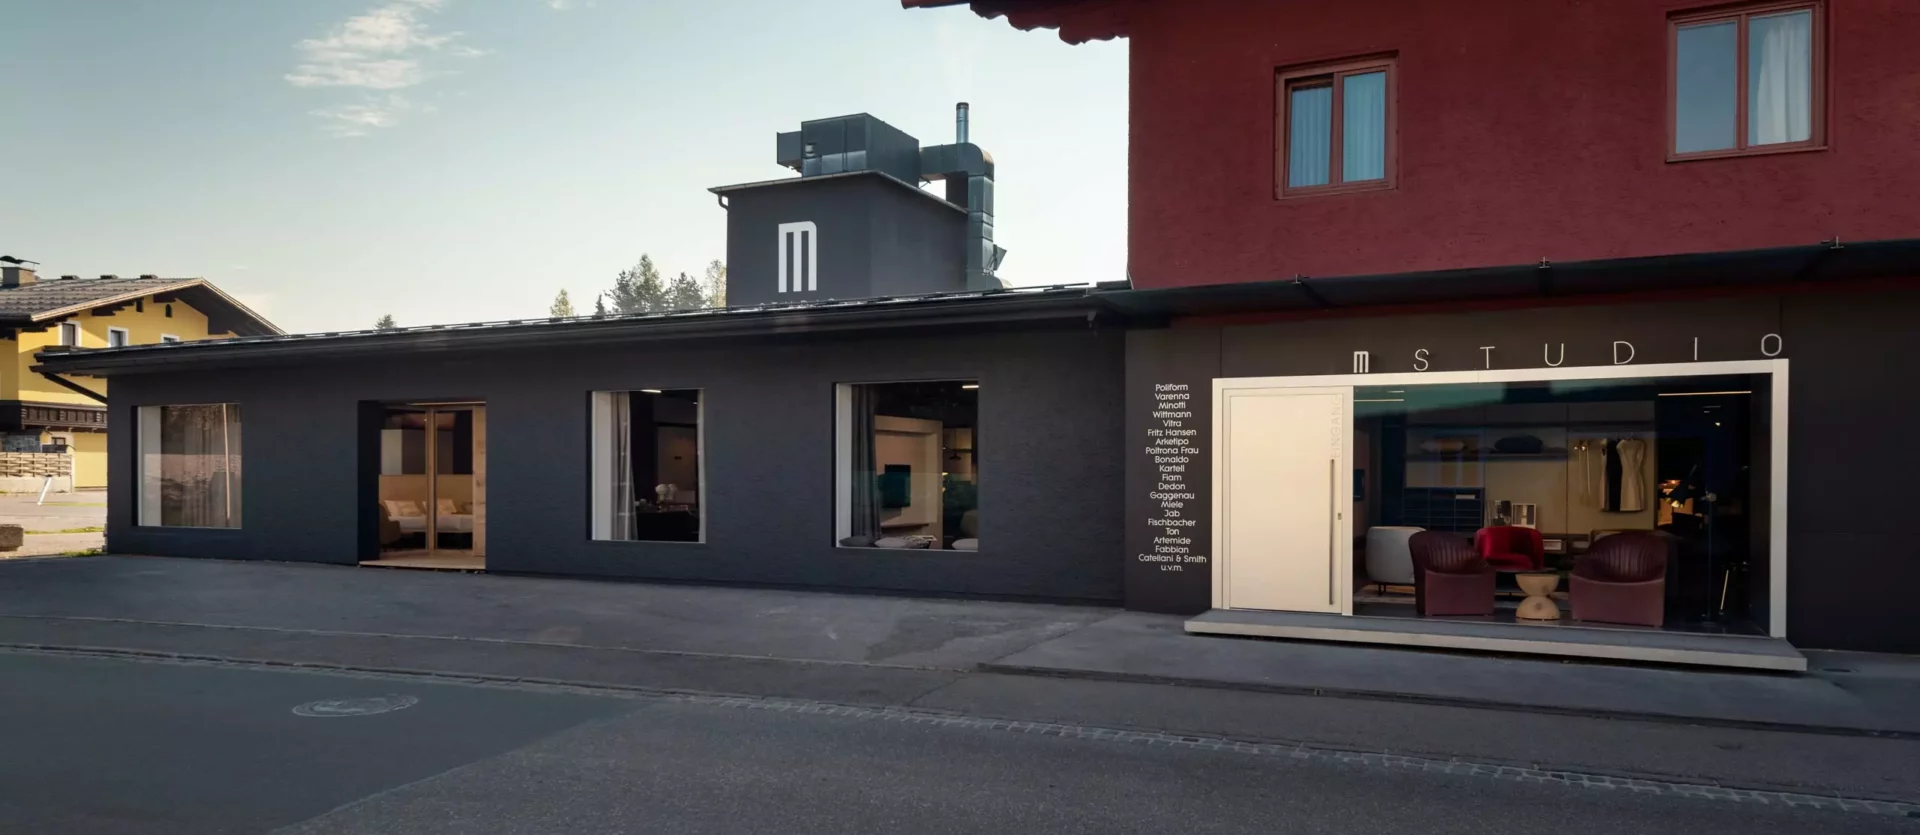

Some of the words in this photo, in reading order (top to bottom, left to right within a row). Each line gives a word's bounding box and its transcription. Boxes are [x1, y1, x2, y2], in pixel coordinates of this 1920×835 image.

[1413, 333, 1782, 372] STUDIO
[1156, 383, 1188, 391] Poliform
[1155, 392, 1189, 400] Varenna
[1159, 401, 1185, 409] Minotti
[1153, 410, 1191, 418] Wittmann
[1163, 419, 1181, 427] Vitra
[1330, 393, 1341, 459] EINGANG
[1148, 428, 1163, 436] Fritz
[1166, 428, 1196, 436] Hansen
[1156, 438, 1189, 446] Arketipo
[1146, 446, 1178, 454] Poltrona
[1181, 446, 1198, 454] Frau
[1155, 455, 1189, 463] Bonaldo
[1160, 464, 1184, 472] Kartell
[1162, 473, 1182, 481] Fiam
[1159, 482, 1185, 490] Dedon
[1150, 492, 1194, 500] Gaggenau
[1161, 500, 1183, 508] Miele
[1165, 509, 1180, 517] Jab
[1148, 518, 1196, 526] Fischbacher
[1166, 527, 1179, 535] Ton
[1154, 536, 1191, 544] Artemide
[1156, 545, 1189, 553] Fabbian
[1139, 553, 1173, 561] Catellani
[1176, 554, 1181, 562] &
[1184, 554, 1206, 562] Smith
[1160, 564, 1184, 572] u.v.m.
